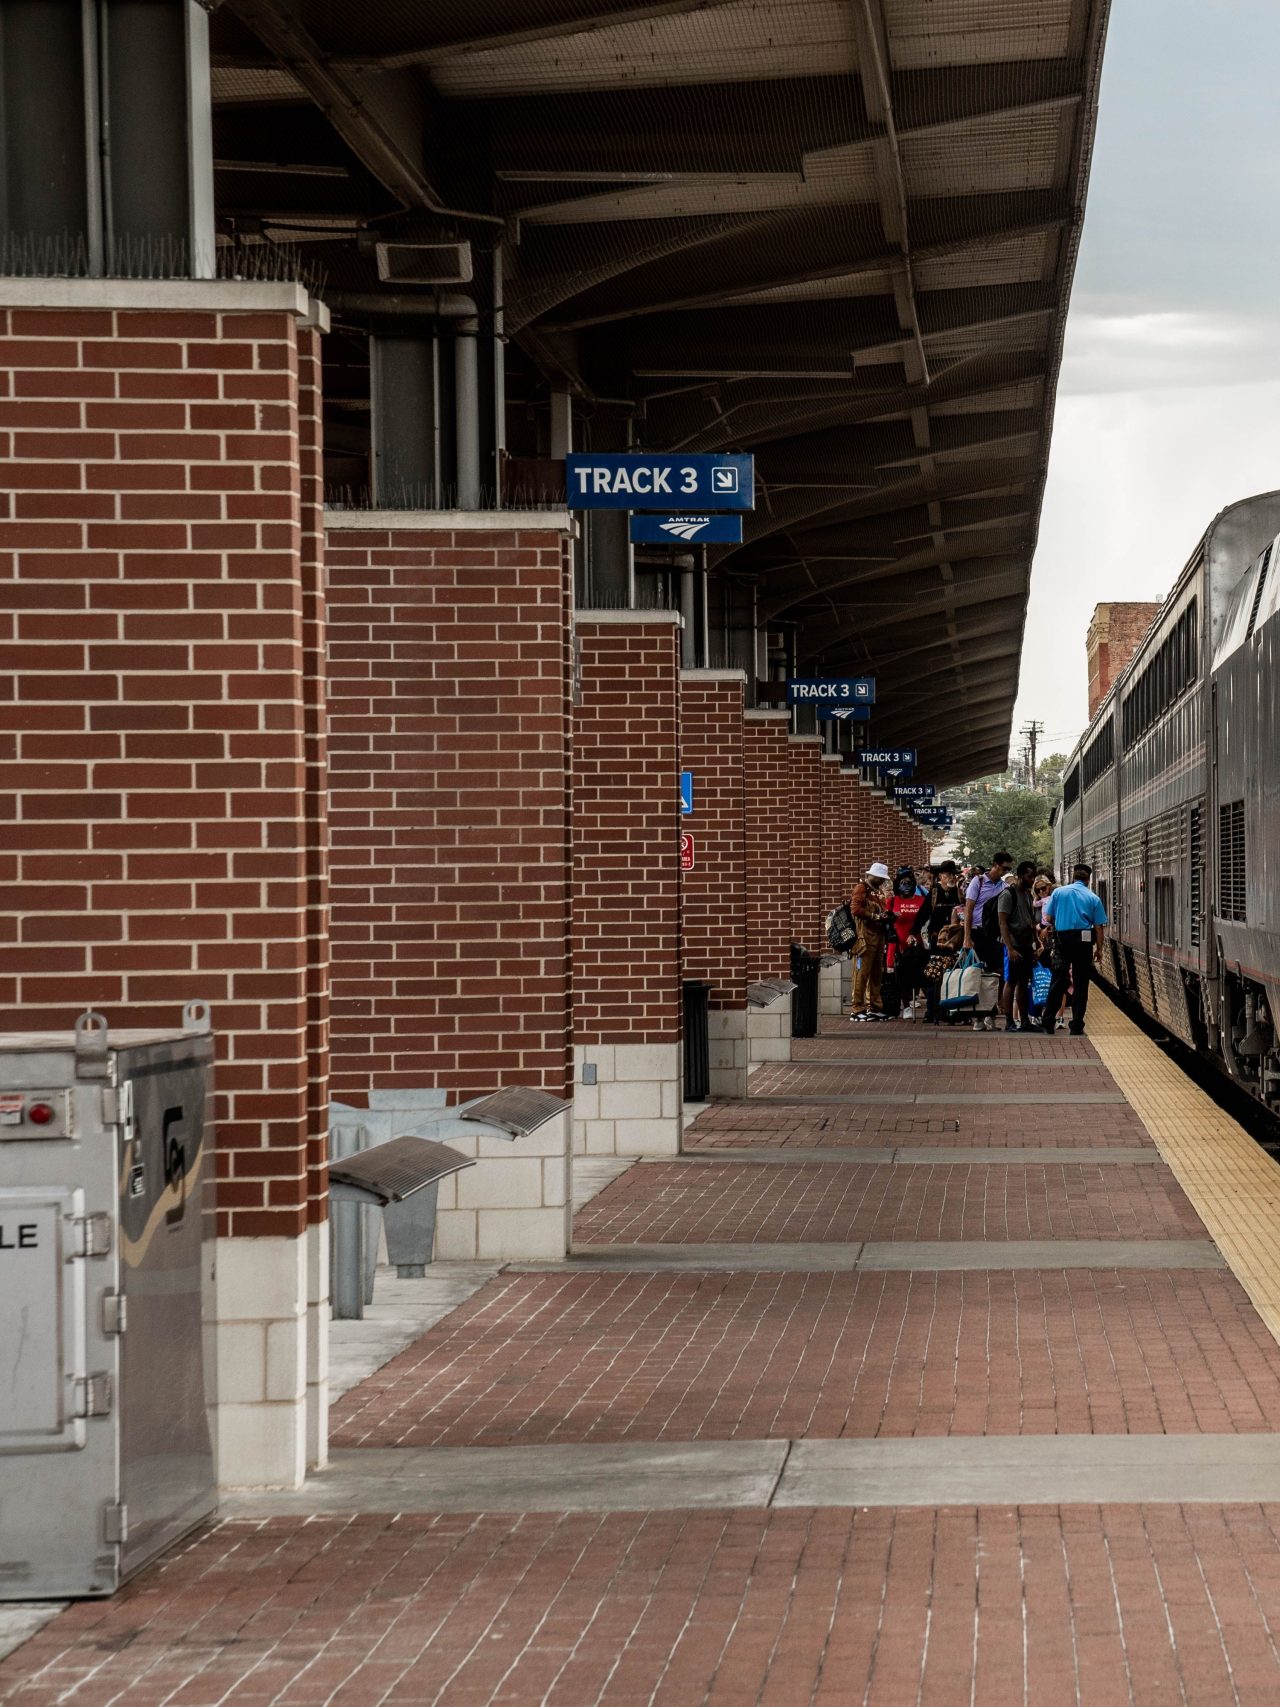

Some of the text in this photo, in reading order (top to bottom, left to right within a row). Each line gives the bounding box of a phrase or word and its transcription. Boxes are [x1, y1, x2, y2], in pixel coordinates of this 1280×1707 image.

[574, 467, 698, 494] TRACK 3
[791, 684, 850, 698] TRACK 3
[861, 753, 900, 762] TRACK 3
[894, 787, 917, 795] TRACK
